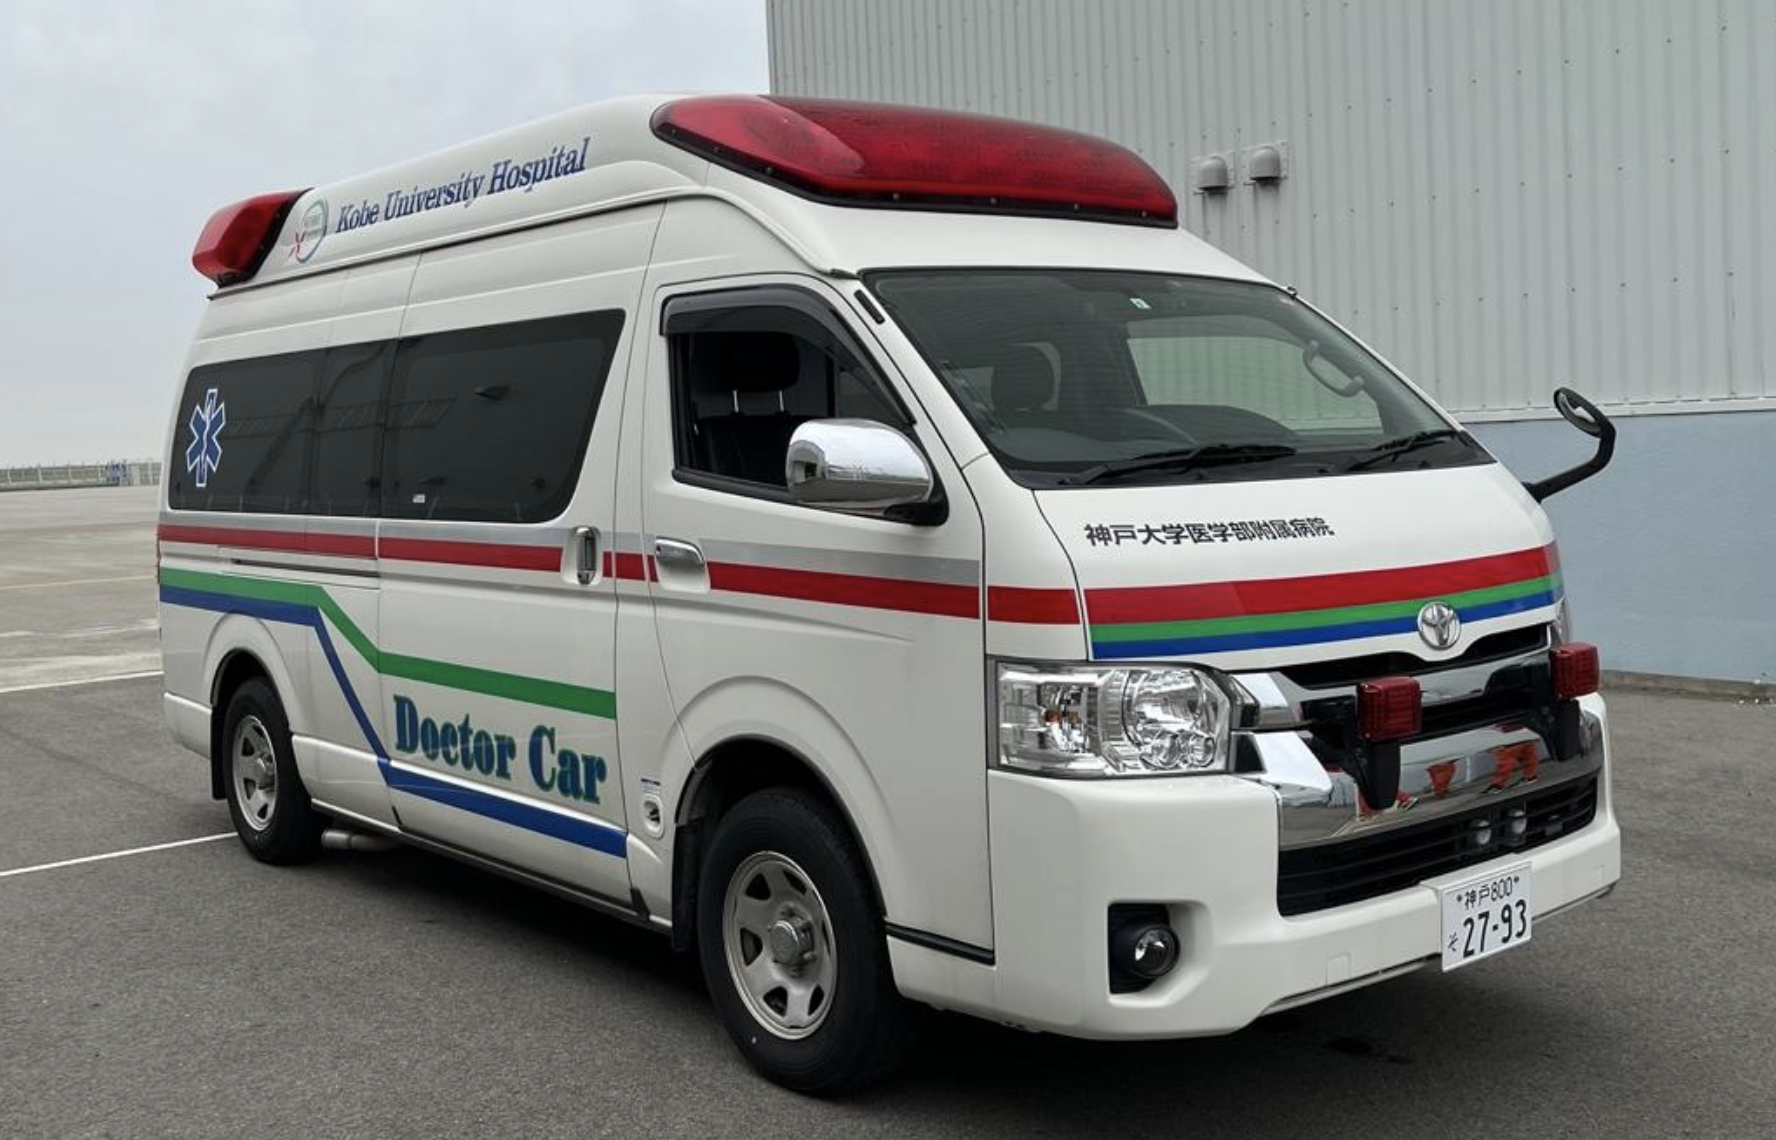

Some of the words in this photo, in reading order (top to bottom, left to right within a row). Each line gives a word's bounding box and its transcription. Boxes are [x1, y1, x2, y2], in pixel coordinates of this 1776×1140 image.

[335, 203, 379, 233] Kobe
[384, 173, 486, 221] University
[487, 137, 591, 196] Hospital
[1084, 517, 1335, 546] 神戸大学医学部附属病院
[393, 694, 516, 780] Doctor
[528, 725, 607, 804] Car
